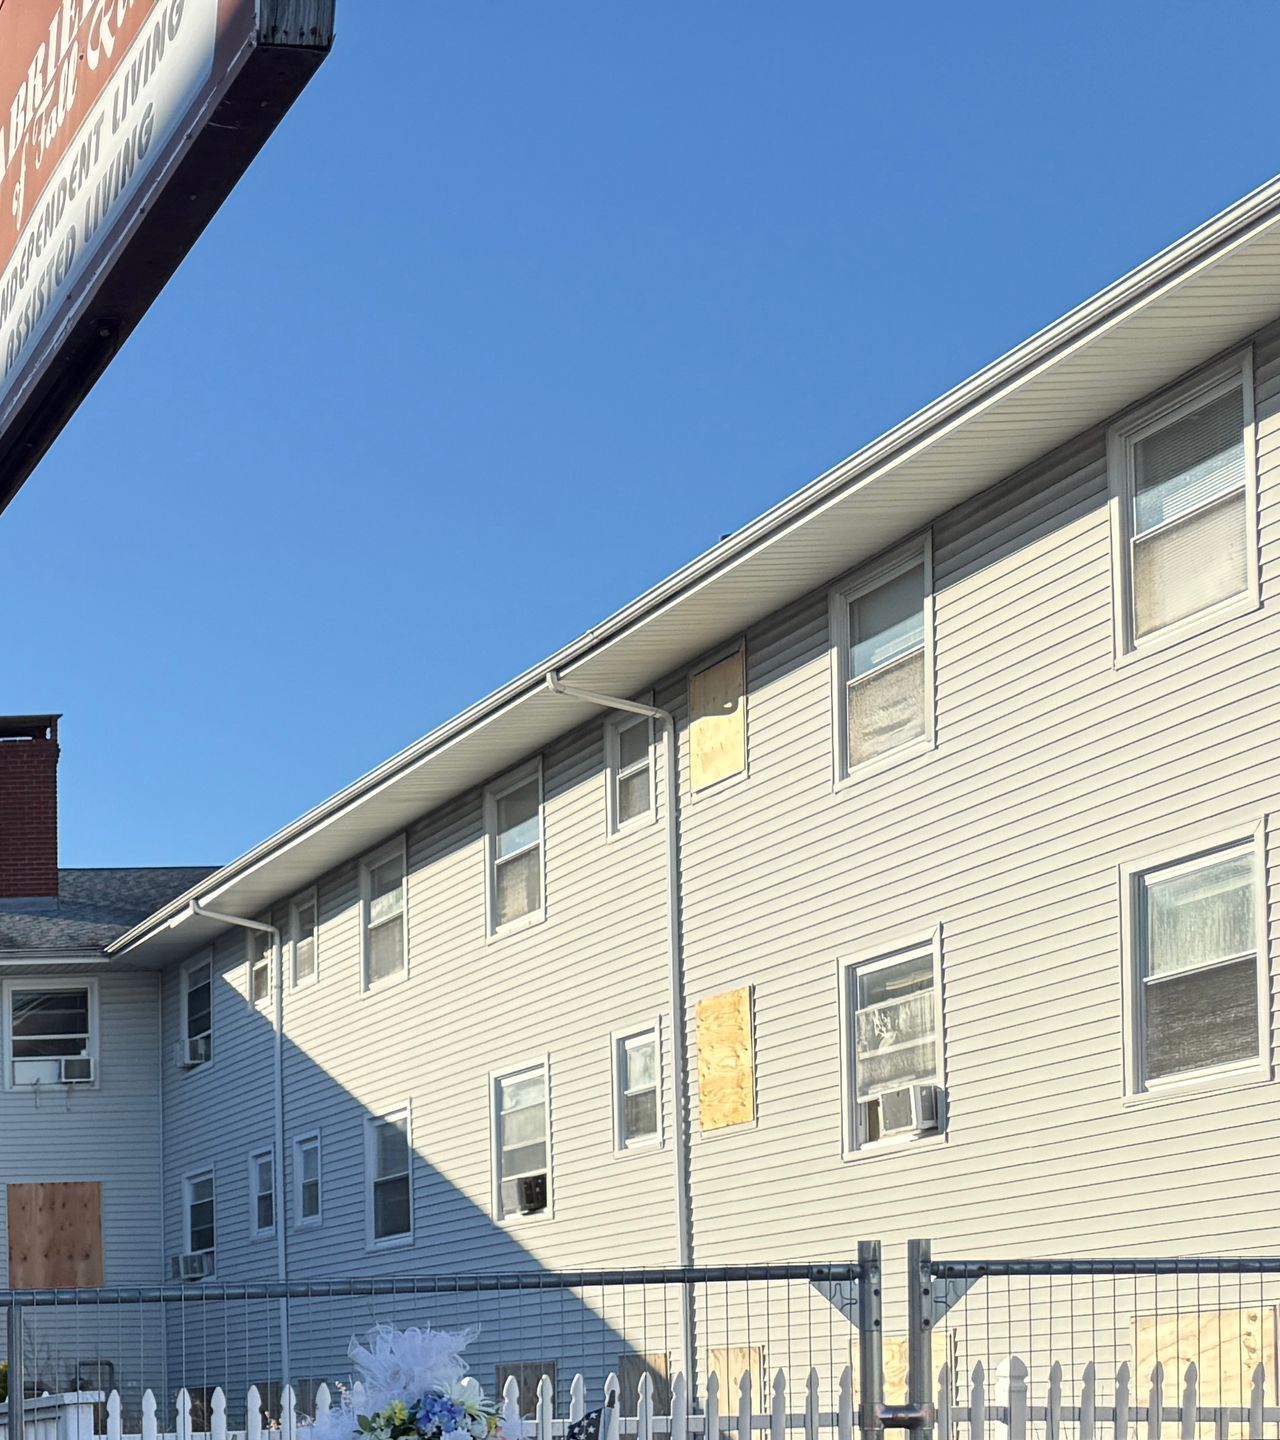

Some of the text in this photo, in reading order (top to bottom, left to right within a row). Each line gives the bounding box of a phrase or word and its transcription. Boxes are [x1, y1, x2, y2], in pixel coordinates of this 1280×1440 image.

[112, 0, 185, 135] LIVING
[5, 102, 155, 376] ASSISTED LIVING
